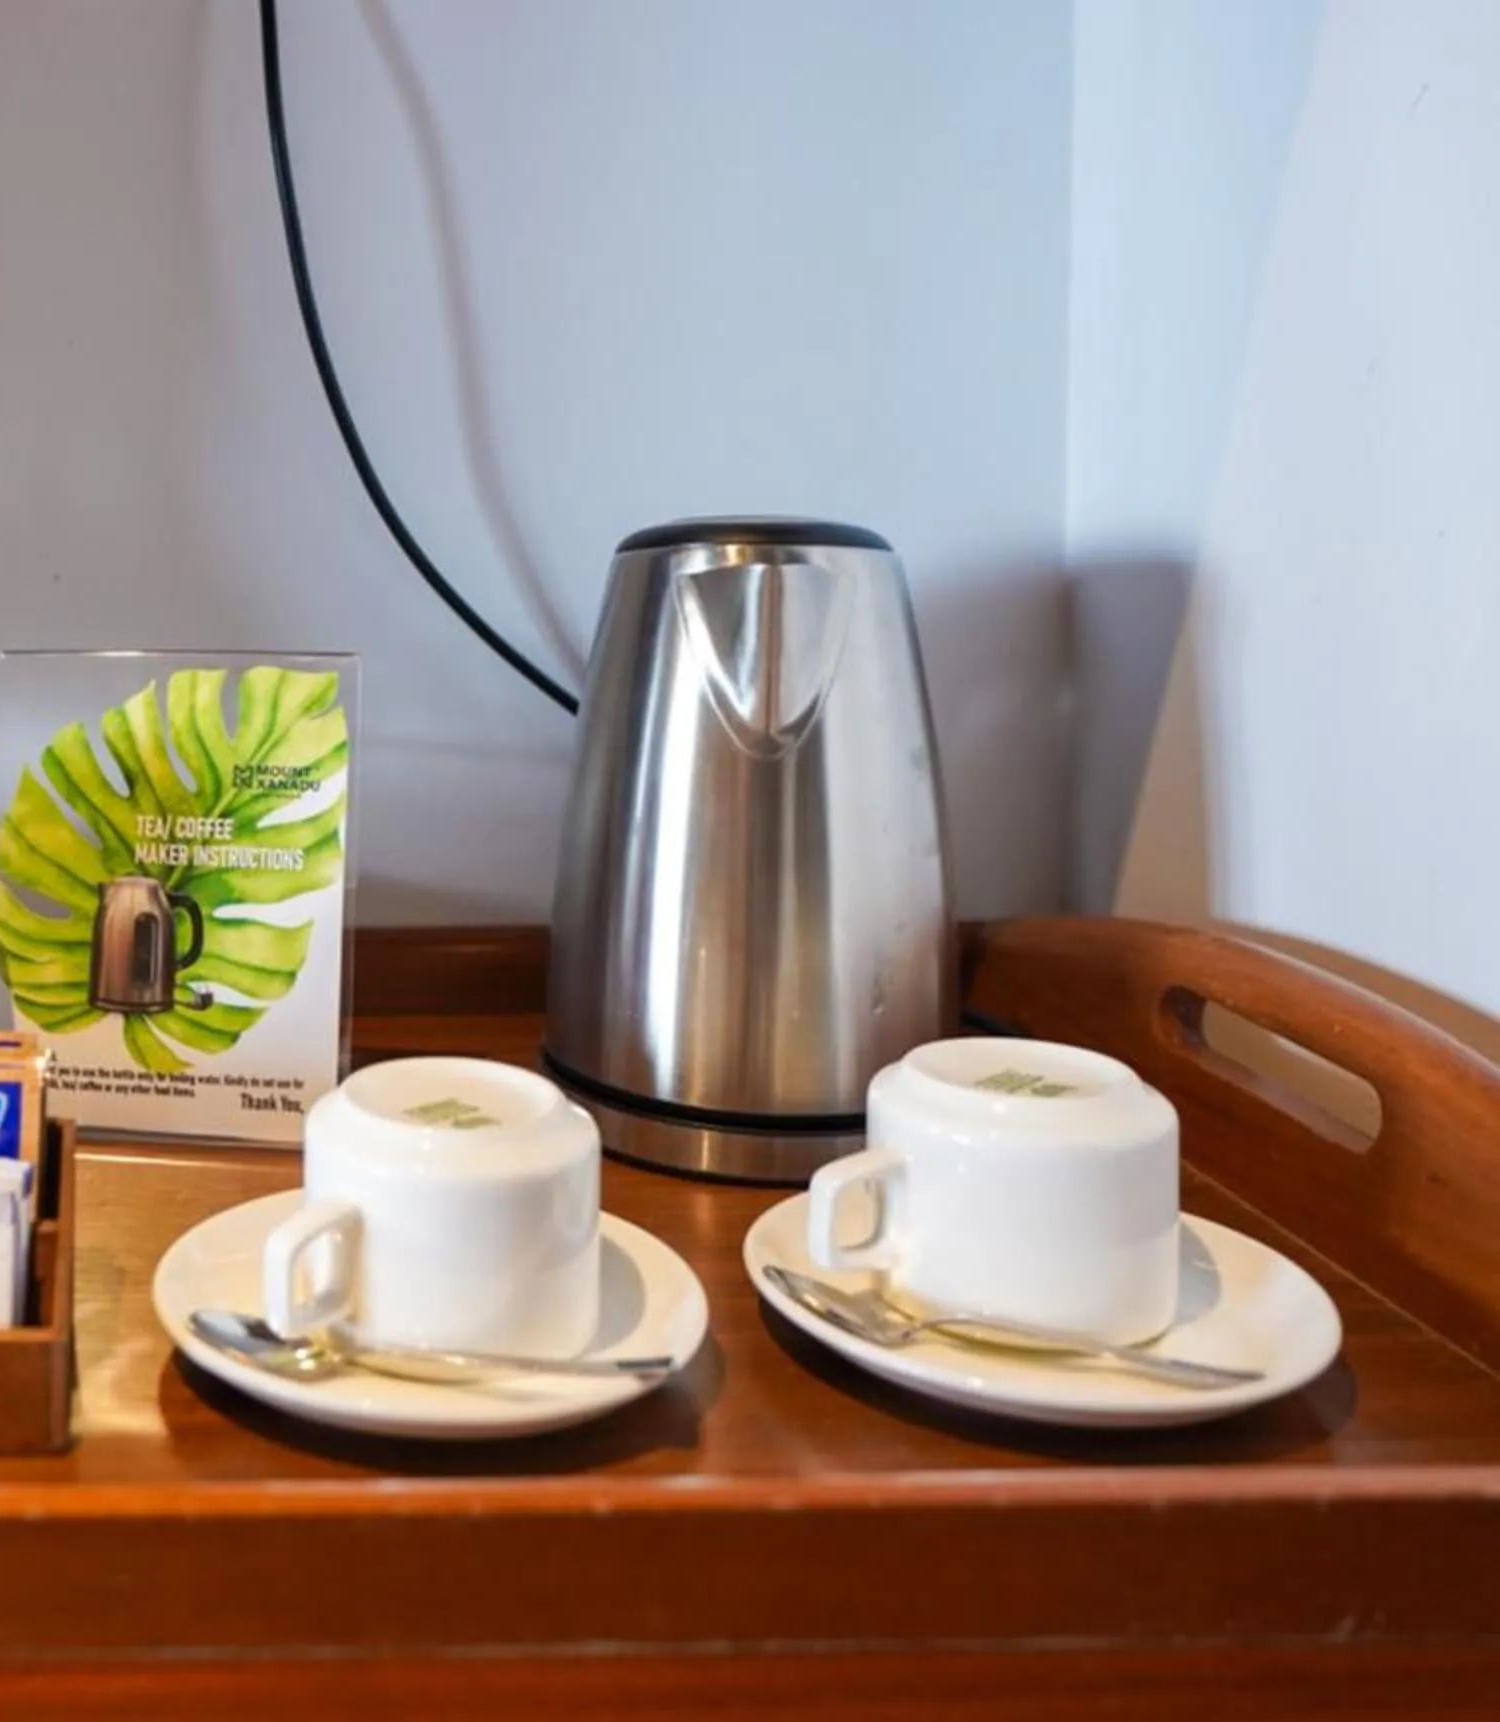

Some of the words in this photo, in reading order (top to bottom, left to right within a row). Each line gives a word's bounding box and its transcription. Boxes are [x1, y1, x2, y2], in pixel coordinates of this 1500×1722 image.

[256, 766, 311, 777] MOUNT
[137, 815, 171, 840] TEA/
[175, 816, 234, 840] COFFEE
[135, 843, 188, 865] MAKER
[193, 845, 305, 871] INSTRUCTIONS
[241, 1092, 277, 1112] Thank
